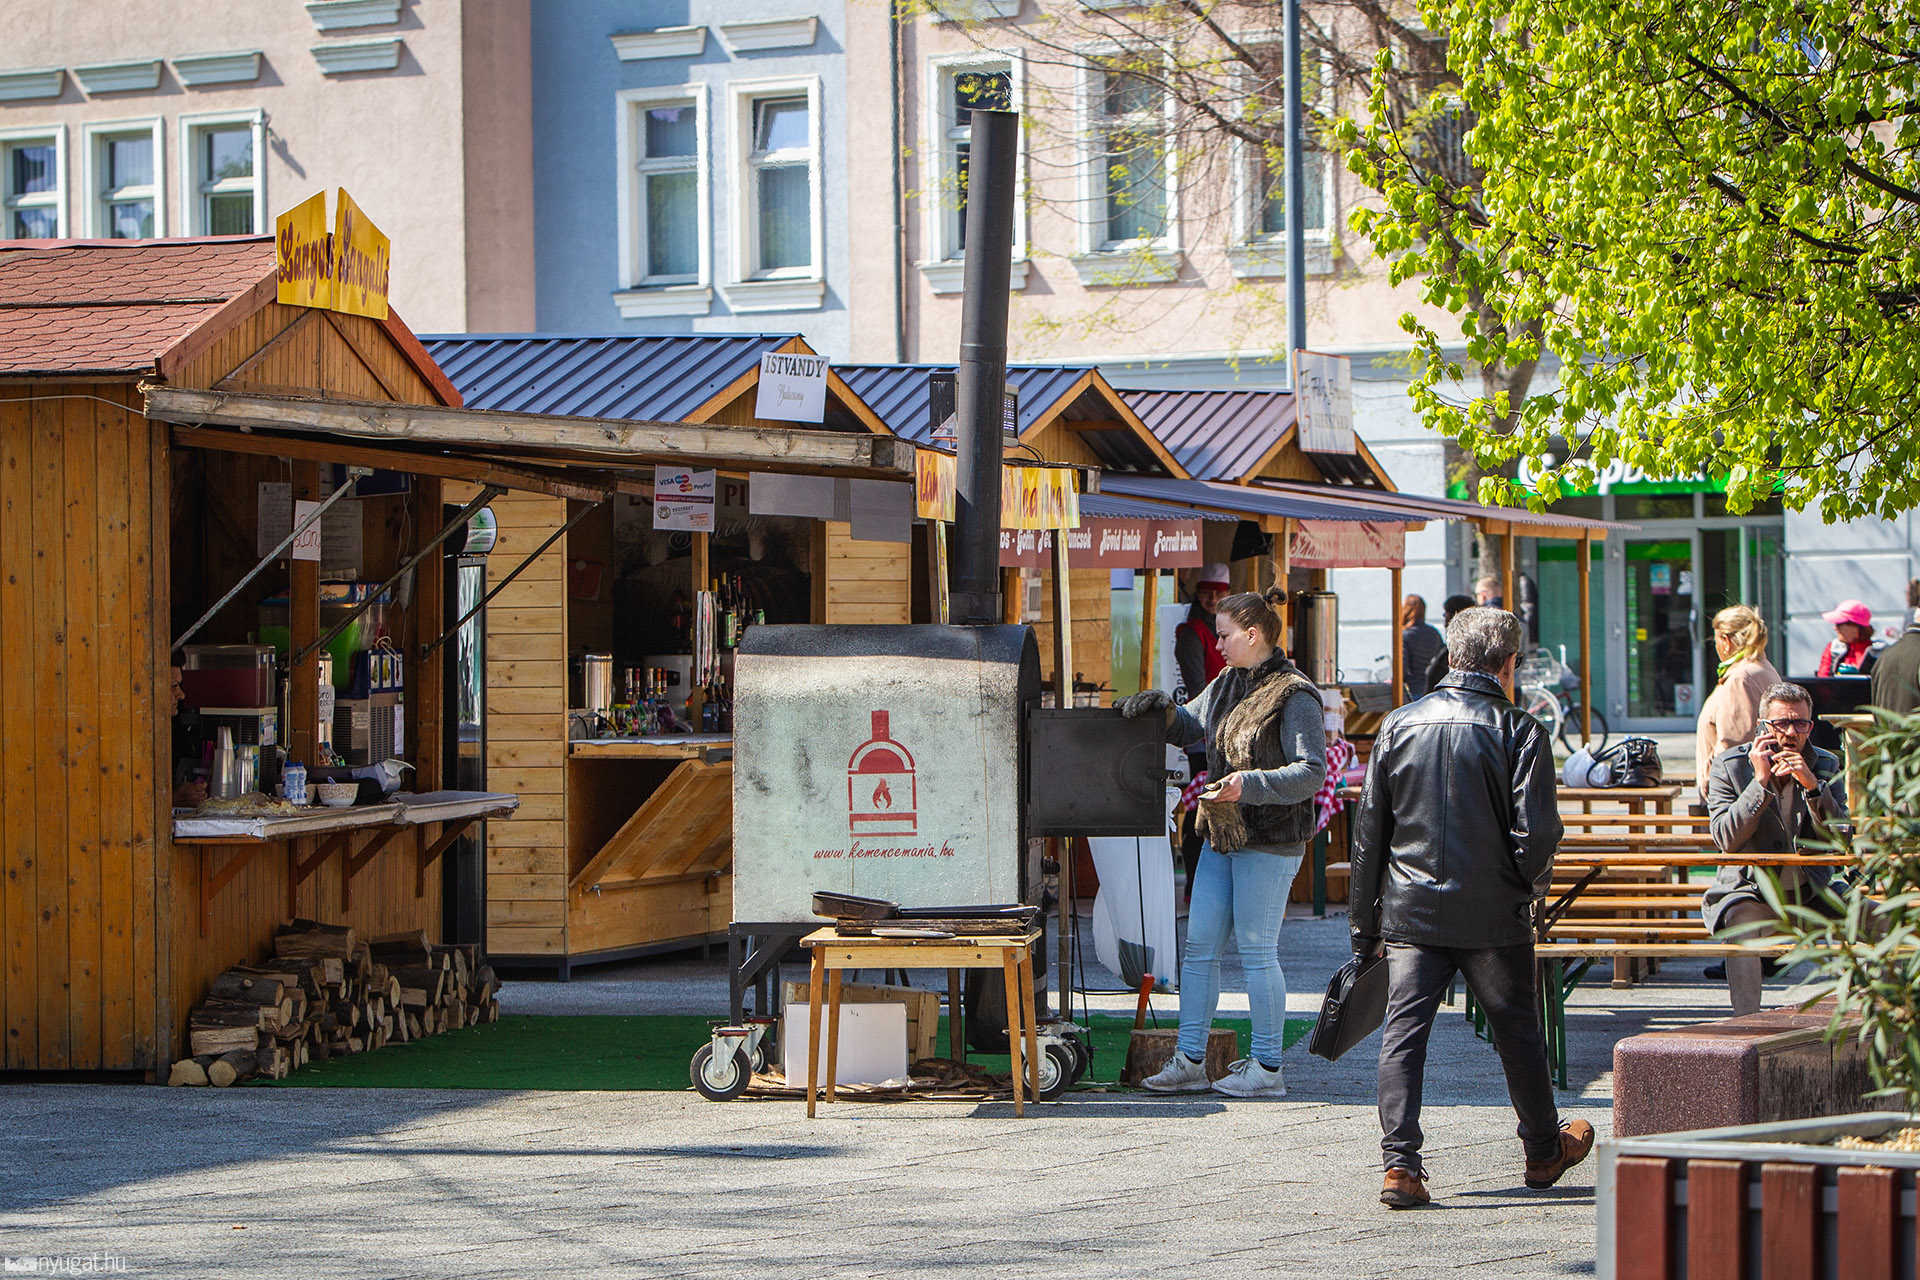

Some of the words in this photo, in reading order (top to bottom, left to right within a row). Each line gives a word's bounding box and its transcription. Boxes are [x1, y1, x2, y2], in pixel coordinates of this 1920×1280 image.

[659, 478, 675, 486] VISA
[1066, 527, 1092, 549] uncsok
[813, 839, 955, 859] www.kemencemania.hu
